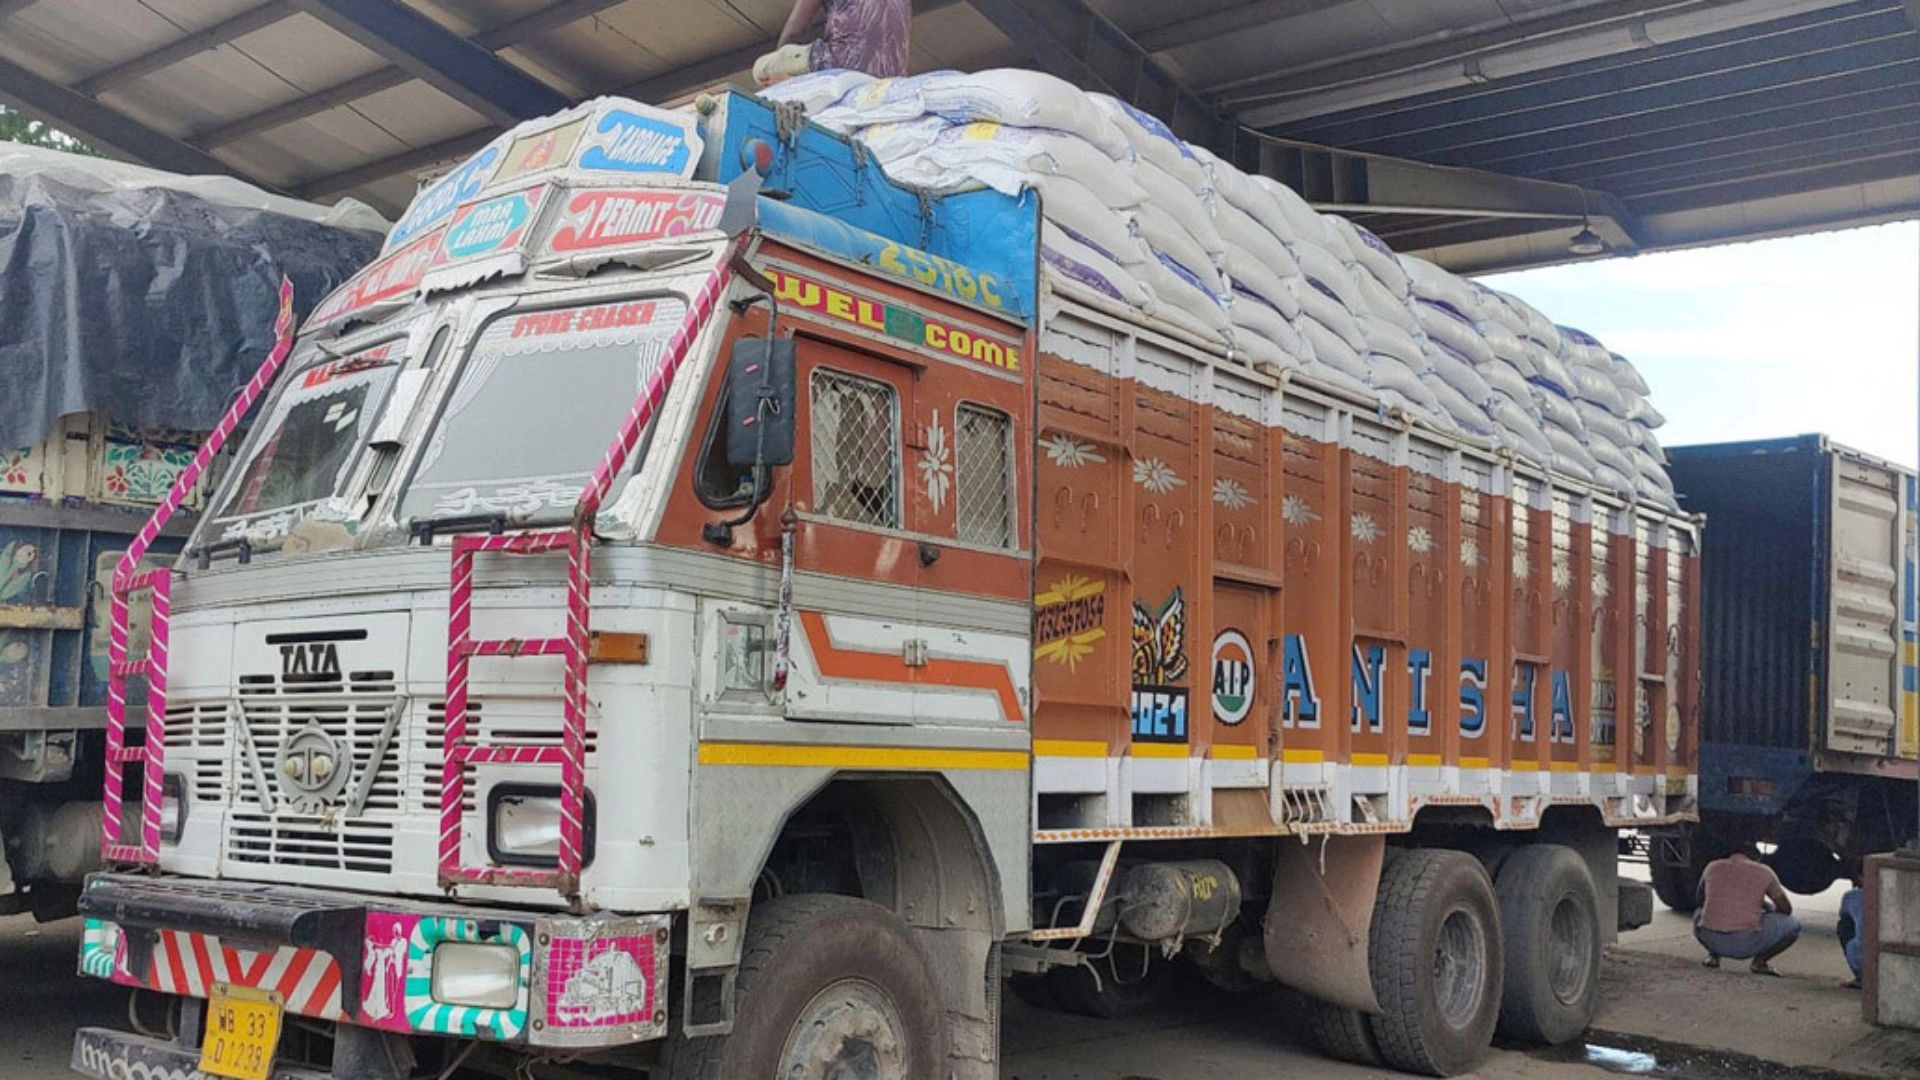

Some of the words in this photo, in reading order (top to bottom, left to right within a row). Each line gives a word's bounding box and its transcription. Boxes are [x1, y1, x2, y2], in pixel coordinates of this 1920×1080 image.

[589, 197, 673, 239] PERMIT
[763, 270, 885, 331] WEL
[926, 322, 1020, 370] COME
[280, 643, 342, 673] TATA
[1282, 633, 1575, 744] ANISHA
[218, 1008, 234, 1034] WB
[248, 1011, 266, 1039] 33
